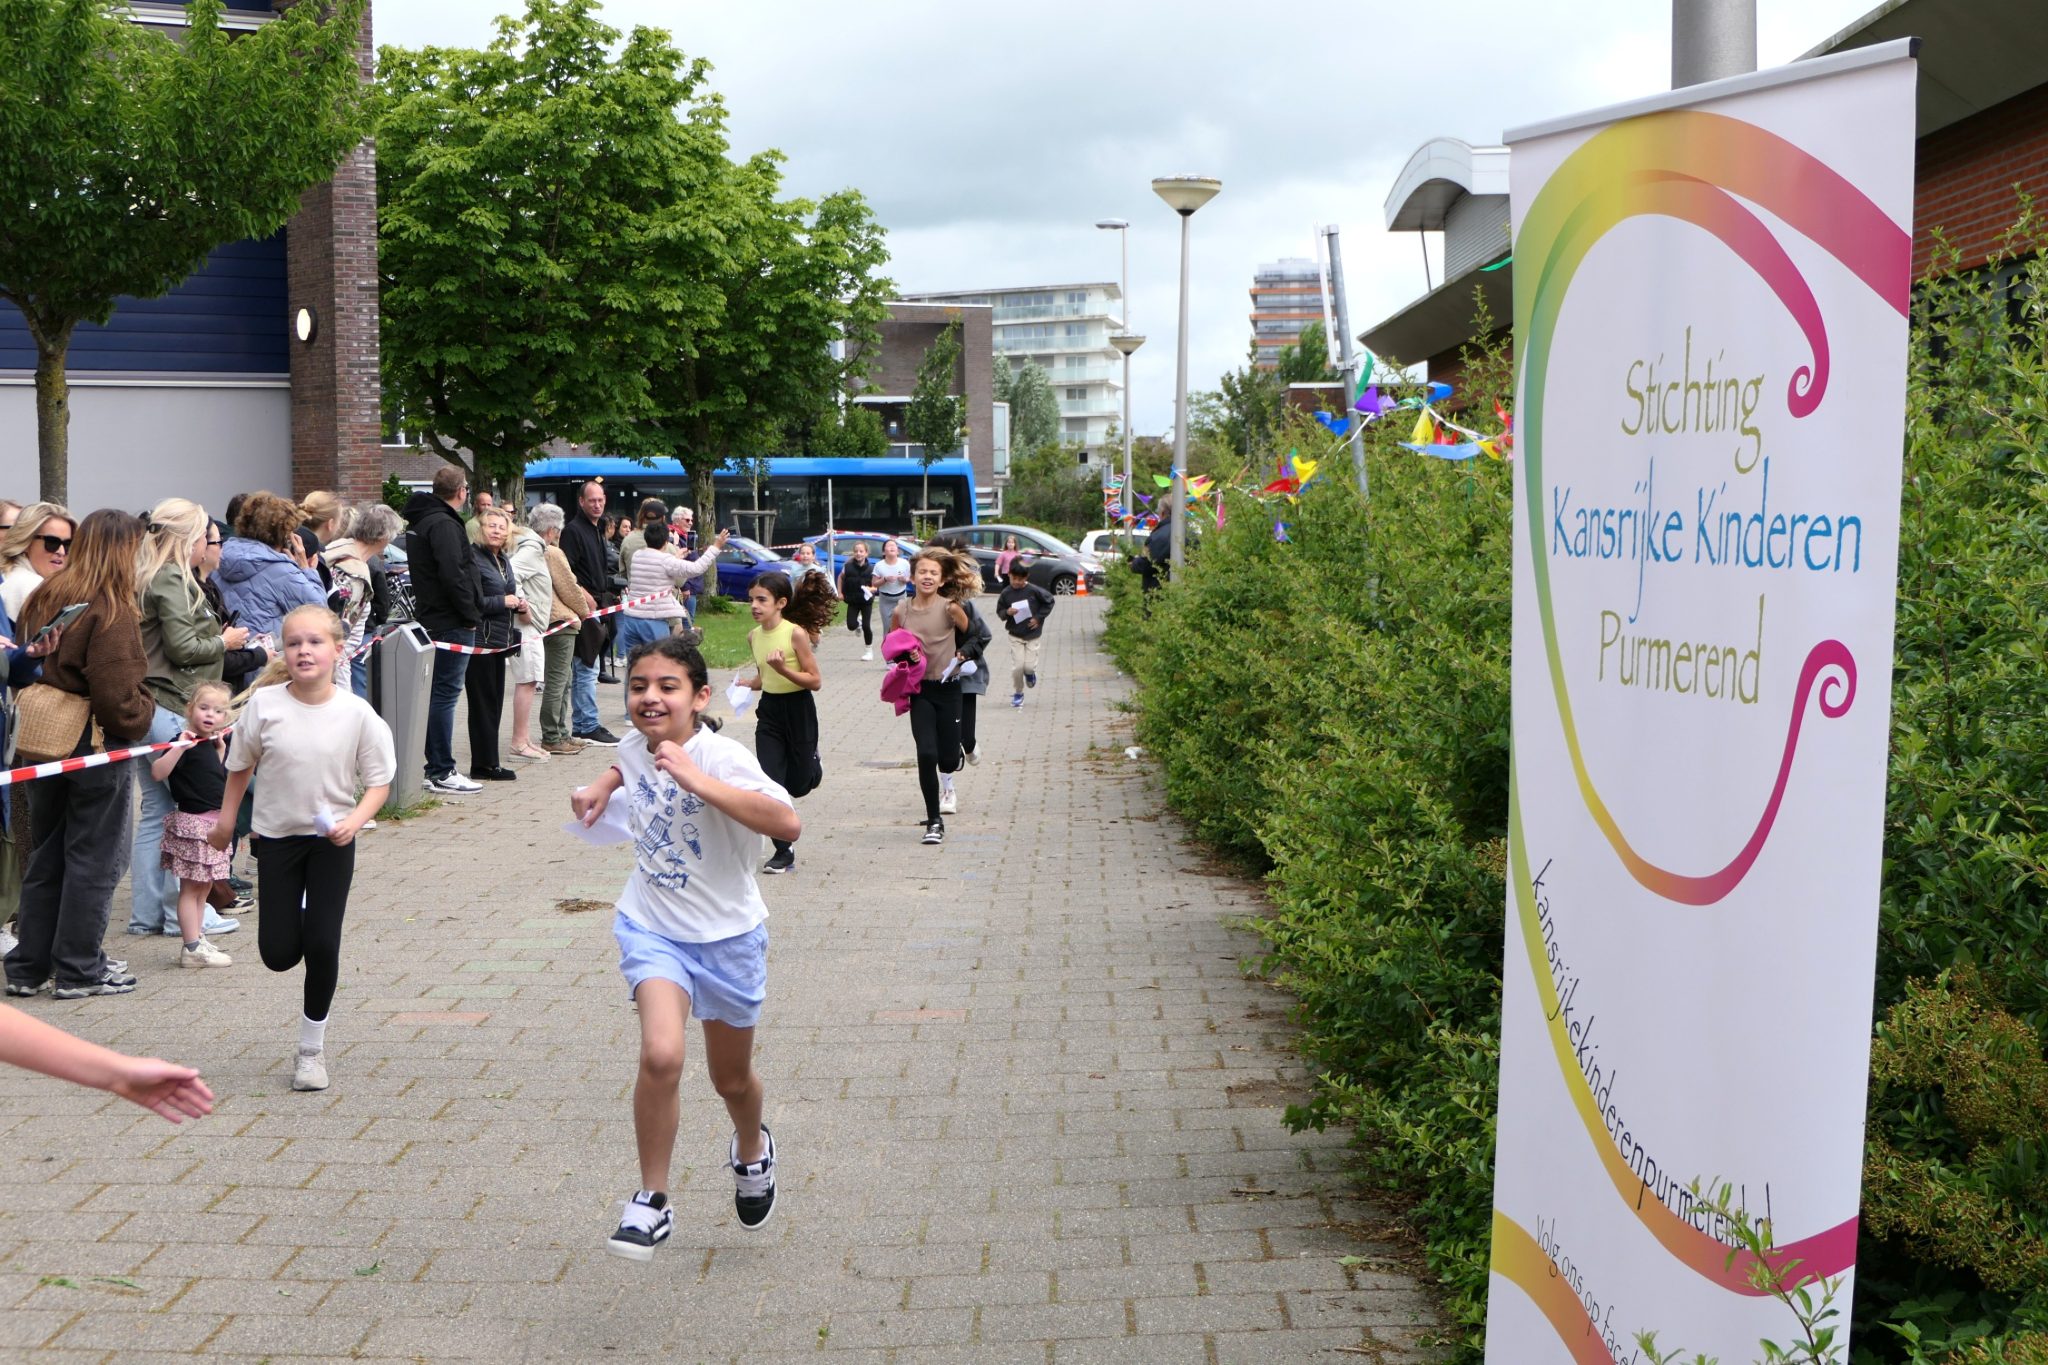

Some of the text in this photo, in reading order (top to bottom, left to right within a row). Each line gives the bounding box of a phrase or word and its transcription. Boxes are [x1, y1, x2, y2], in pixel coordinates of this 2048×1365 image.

[1622, 326, 1764, 474] Stichting
[1553, 457, 1861, 623] Kansrijke Kinderen
[1600, 594, 1764, 704] Purmerend
[1537, 1215, 1560, 1277] Volg
[1562, 1257, 1583, 1294] ons
[1585, 1291, 1599, 1336] op
